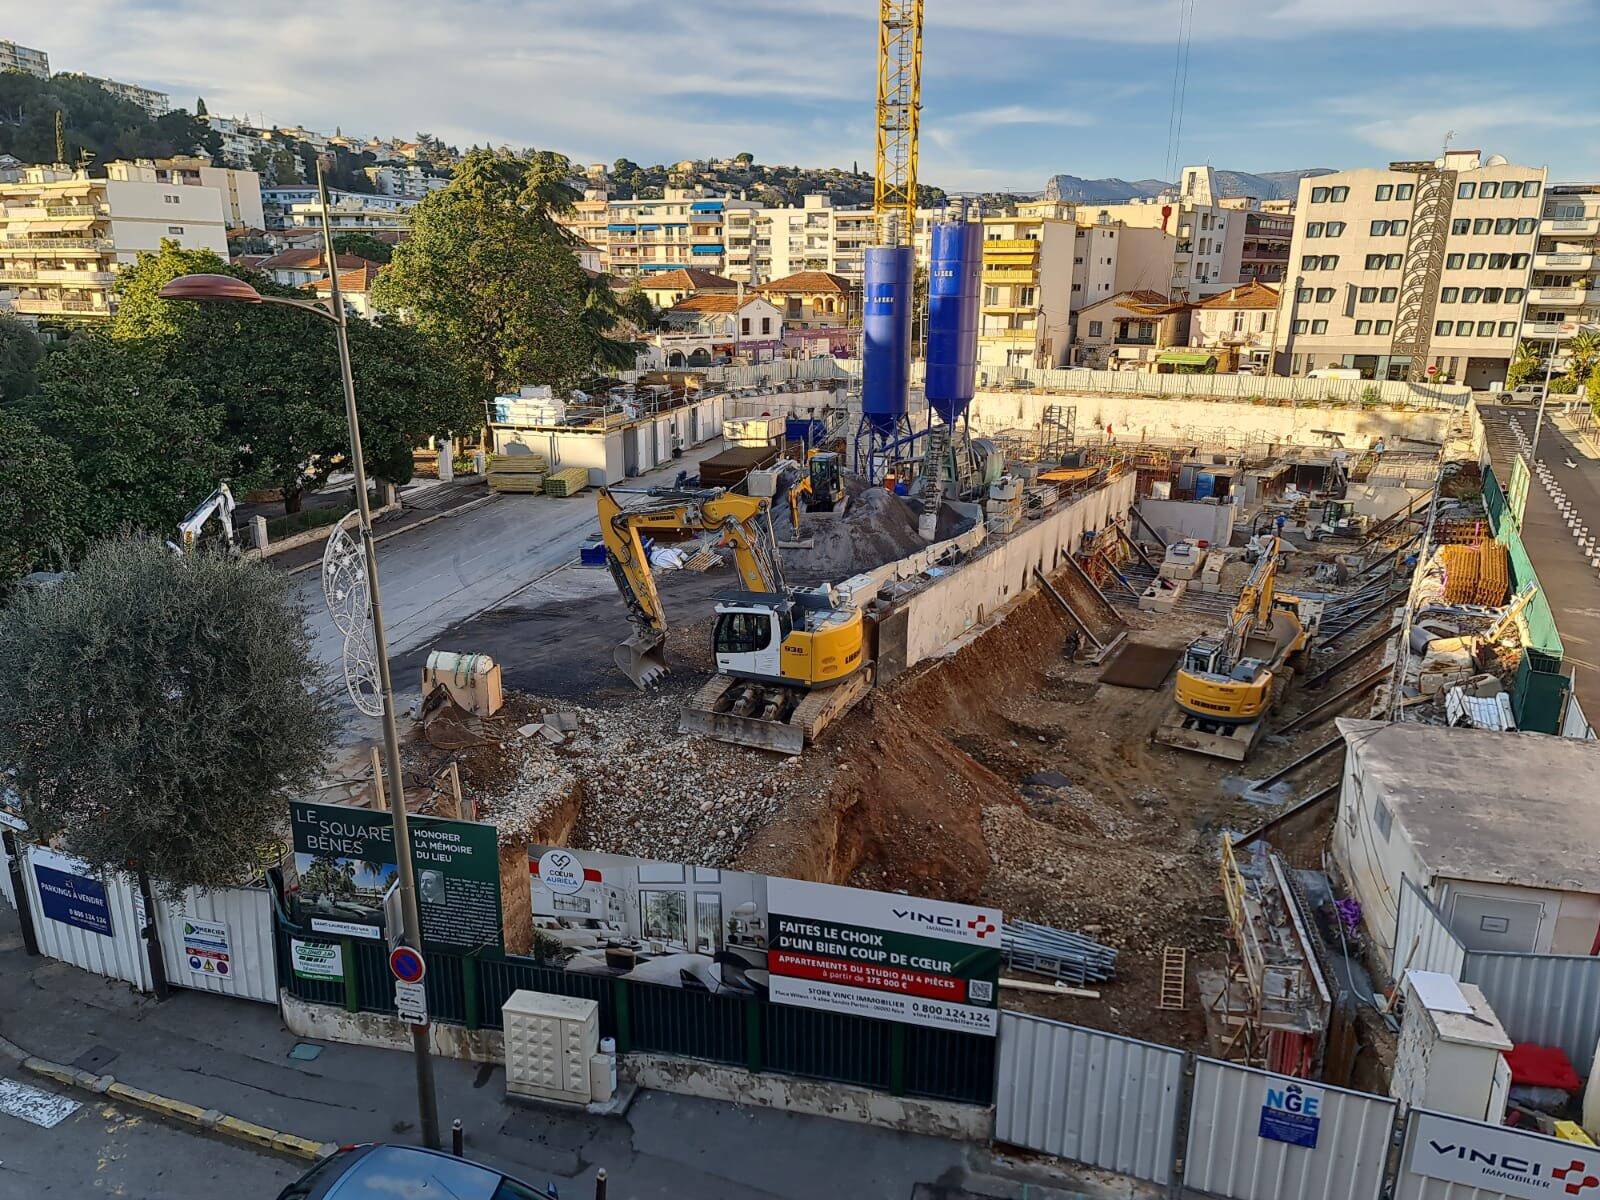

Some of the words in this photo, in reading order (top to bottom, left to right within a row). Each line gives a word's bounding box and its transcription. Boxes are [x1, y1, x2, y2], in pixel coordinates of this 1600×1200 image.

[296, 808, 318, 824] LE
[319, 820, 392, 842] SQUARE
[413, 829, 461, 842] HONORER
[415, 840, 427, 849] LA
[429, 841, 473, 855] MÉMOIRE
[416, 850, 430, 860] DU
[431, 852, 452, 863] LIEU
[40, 882, 72, 898] PARKINGS
[78, 892, 104, 907] VENDRE
[892, 908, 961, 928] VINCI
[779, 920, 821, 937] FAITES
[823, 927, 839, 940] LE
[840, 930, 883, 947] CHOIX
[926, 924, 968, 937] IMMOBILIER
[815, 941, 847, 956] BIEN
[849, 946, 887, 962] COUP
[889, 952, 908, 966] DE
[778, 955, 848, 972] APPARTEMENTS
[850, 964, 864, 974] DU
[864, 966, 899, 980] STUDIO
[900, 972, 914, 982] AU
[916, 974, 923, 984] 4
[924, 975, 956, 989] PIÈCES
[829, 971, 852, 982] partir
[854, 973, 864, 982] de
[866, 976, 881, 986] 175
[883, 978, 900, 988] 000
[808, 987, 831, 997] STORE
[832, 991, 855, 1001] VINCI
[856, 994, 905, 1008] IMMOBILIER
[912, 1002, 919, 1011] 0
[922, 1004, 942, 1015] 800
[945, 1008, 966, 1019] 124
[969, 1012, 990, 1023] 124
[1266, 1088, 1319, 1116] NGE
[1429, 1140, 1541, 1176] VINCI
[1481, 1167, 1551, 1189] IMMOBILIER
